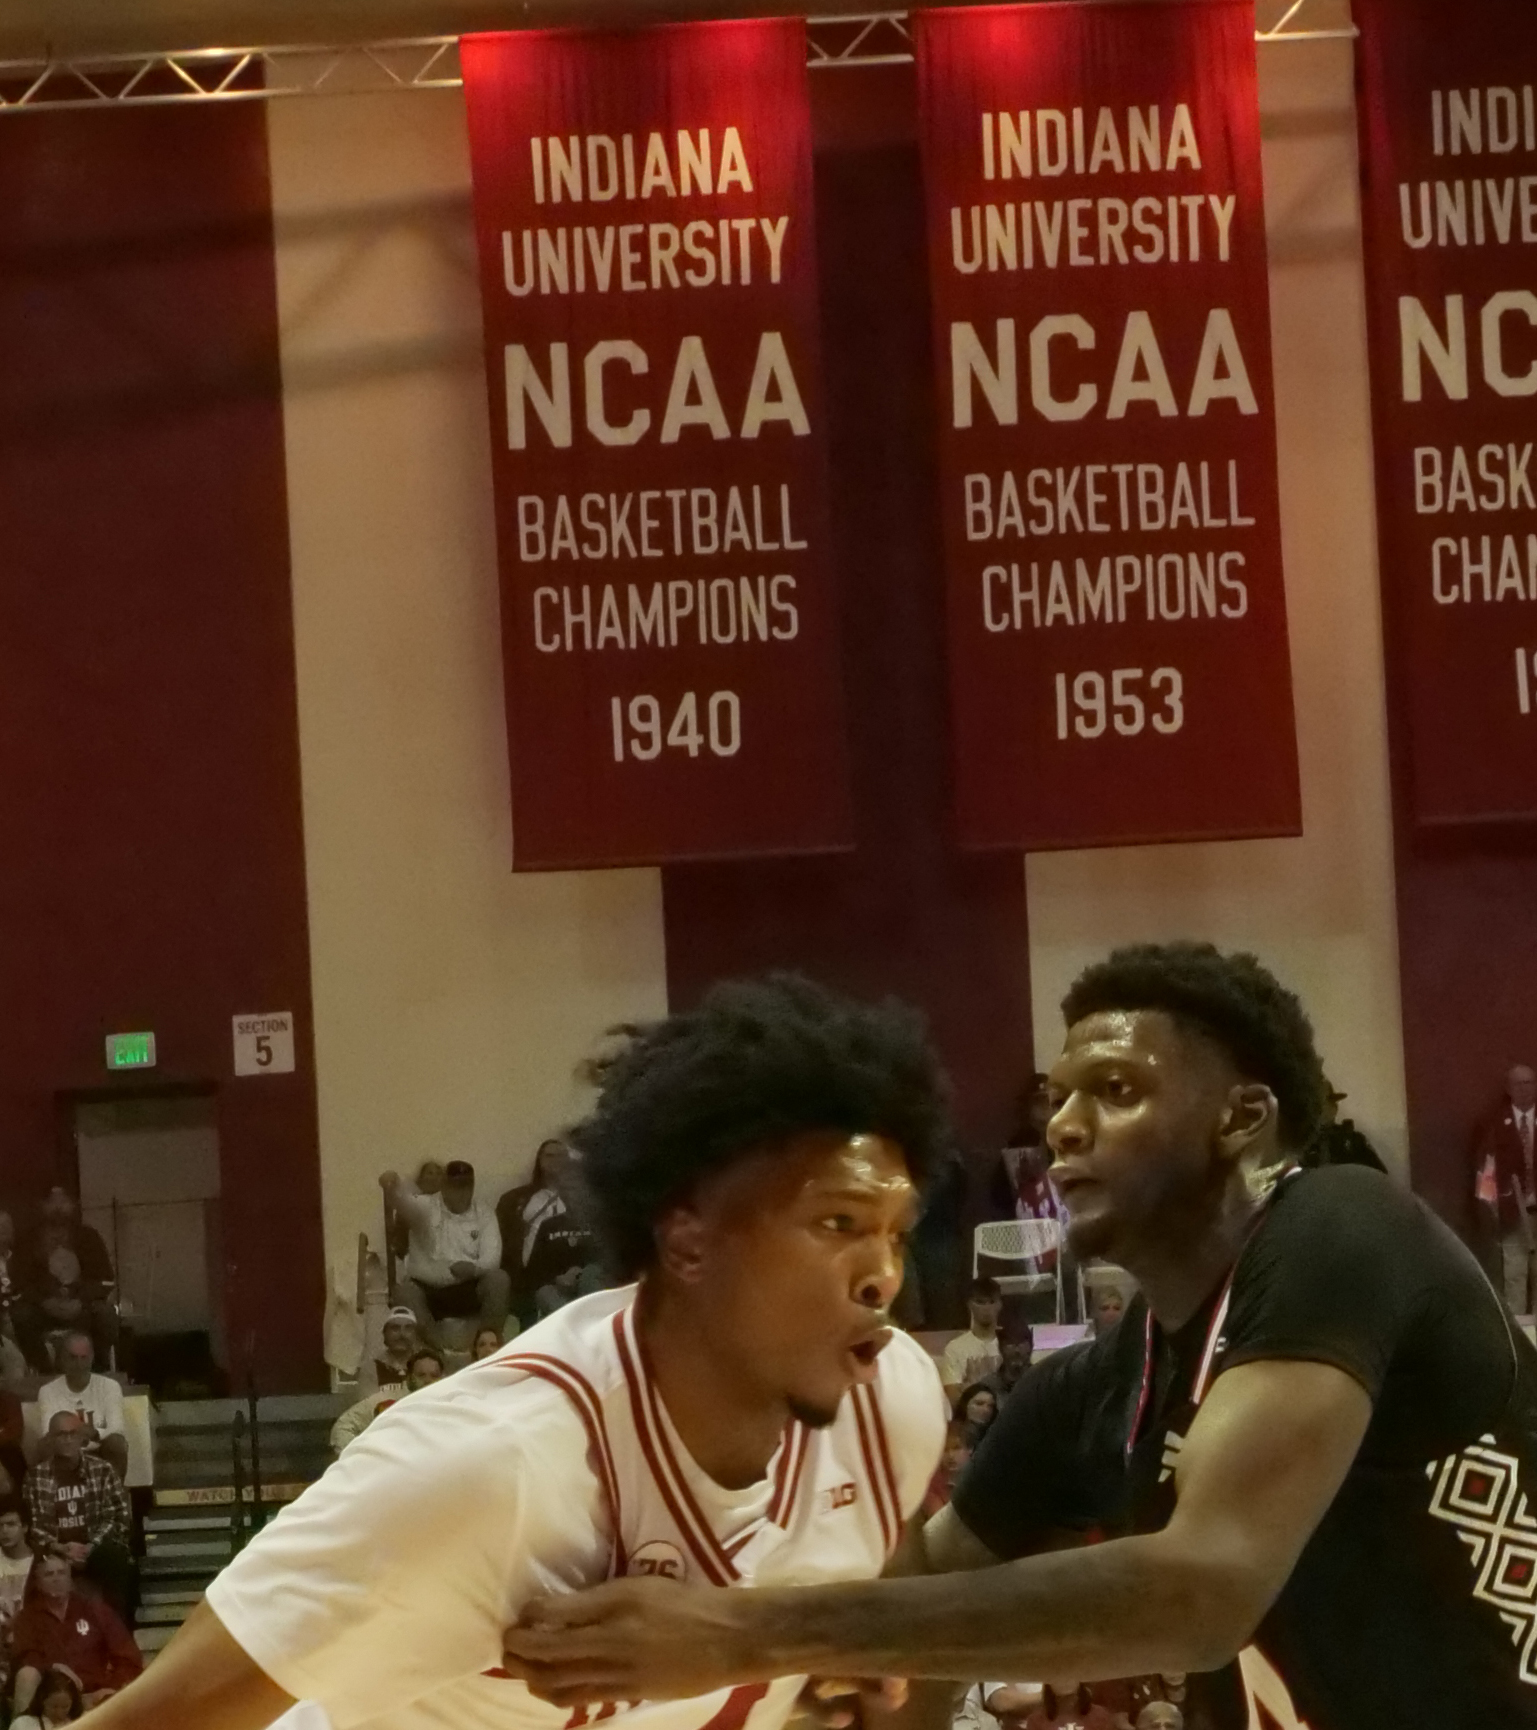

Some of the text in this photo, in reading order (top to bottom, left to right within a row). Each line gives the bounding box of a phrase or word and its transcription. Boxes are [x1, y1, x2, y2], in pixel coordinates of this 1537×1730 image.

[531, 127, 753, 203] INDIANA
[982, 104, 1201, 180] INDIANA
[503, 216, 788, 296] UNIVERSITY
[951, 195, 1235, 274] UNIVERSITY
[505, 332, 810, 449] NCAA
[951, 309, 1258, 428] NCAA
[518, 484, 807, 562] BASKETBALL
[965, 459, 1255, 541] BASKETBALL
[534, 575, 798, 652] CHAMPIONS
[983, 552, 1247, 632] CHAMPIONS
[612, 691, 741, 761] 1940
[1056, 668, 1183, 739] 1953
[237, 1018, 289, 1035] SECTION
[255, 1036, 273, 1067] 5
